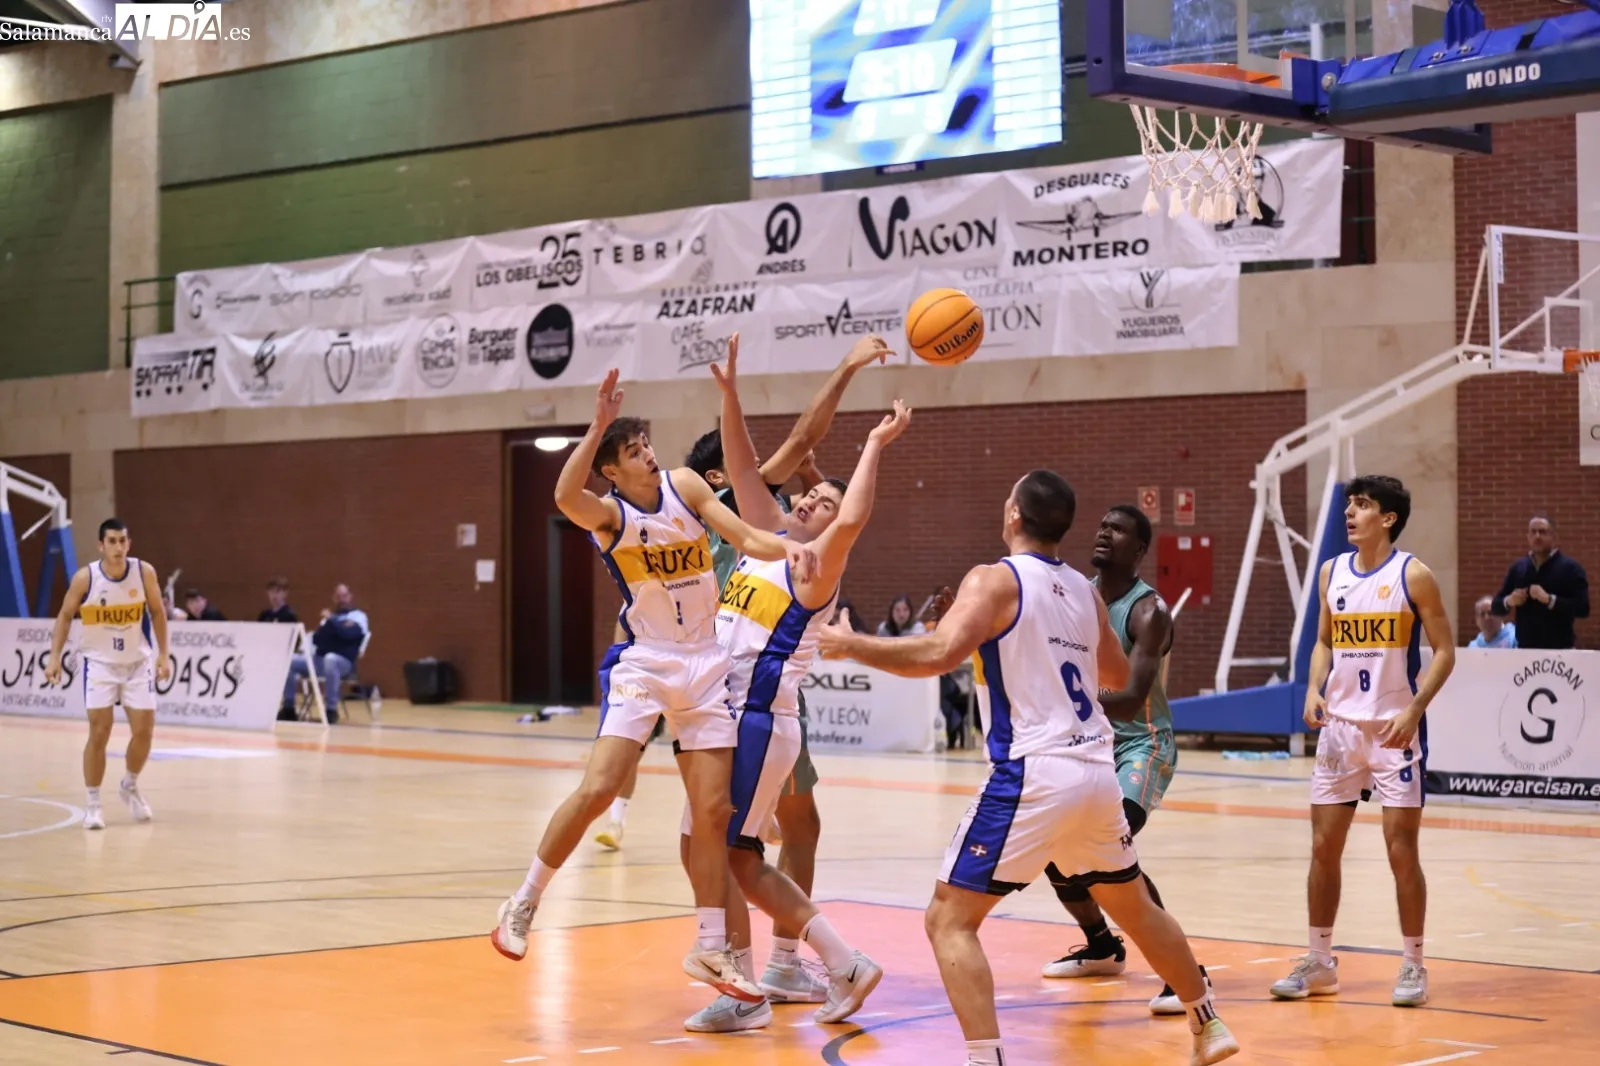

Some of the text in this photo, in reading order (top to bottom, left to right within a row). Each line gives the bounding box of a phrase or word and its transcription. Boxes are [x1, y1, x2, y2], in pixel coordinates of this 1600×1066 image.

[1466, 62, 1541, 90] MONDO
[1034, 172, 1132, 198] DESGUACES
[537, 232, 582, 290] 25
[1012, 237, 1150, 267] MONTERO
[476, 269, 501, 288] LOS
[505, 257, 583, 284] OBELISCOS
[660, 280, 758, 298] RESTAURANTE
[656, 293, 756, 320] AZAFRAN
[775, 316, 903, 340] SPORT CENTER
[932, 320, 979, 357] Wilson
[96, 607, 141, 625] IRUKI
[1334, 617, 1397, 646] IRUKI
[155, 653, 238, 700] OASIS
[1358, 669, 1371, 692] 8
[1513, 658, 1583, 691] GARCISAN
[816, 706, 827, 724] Y
[829, 704, 872, 726] LEÓN
[1538, 744, 1574, 772] animal
